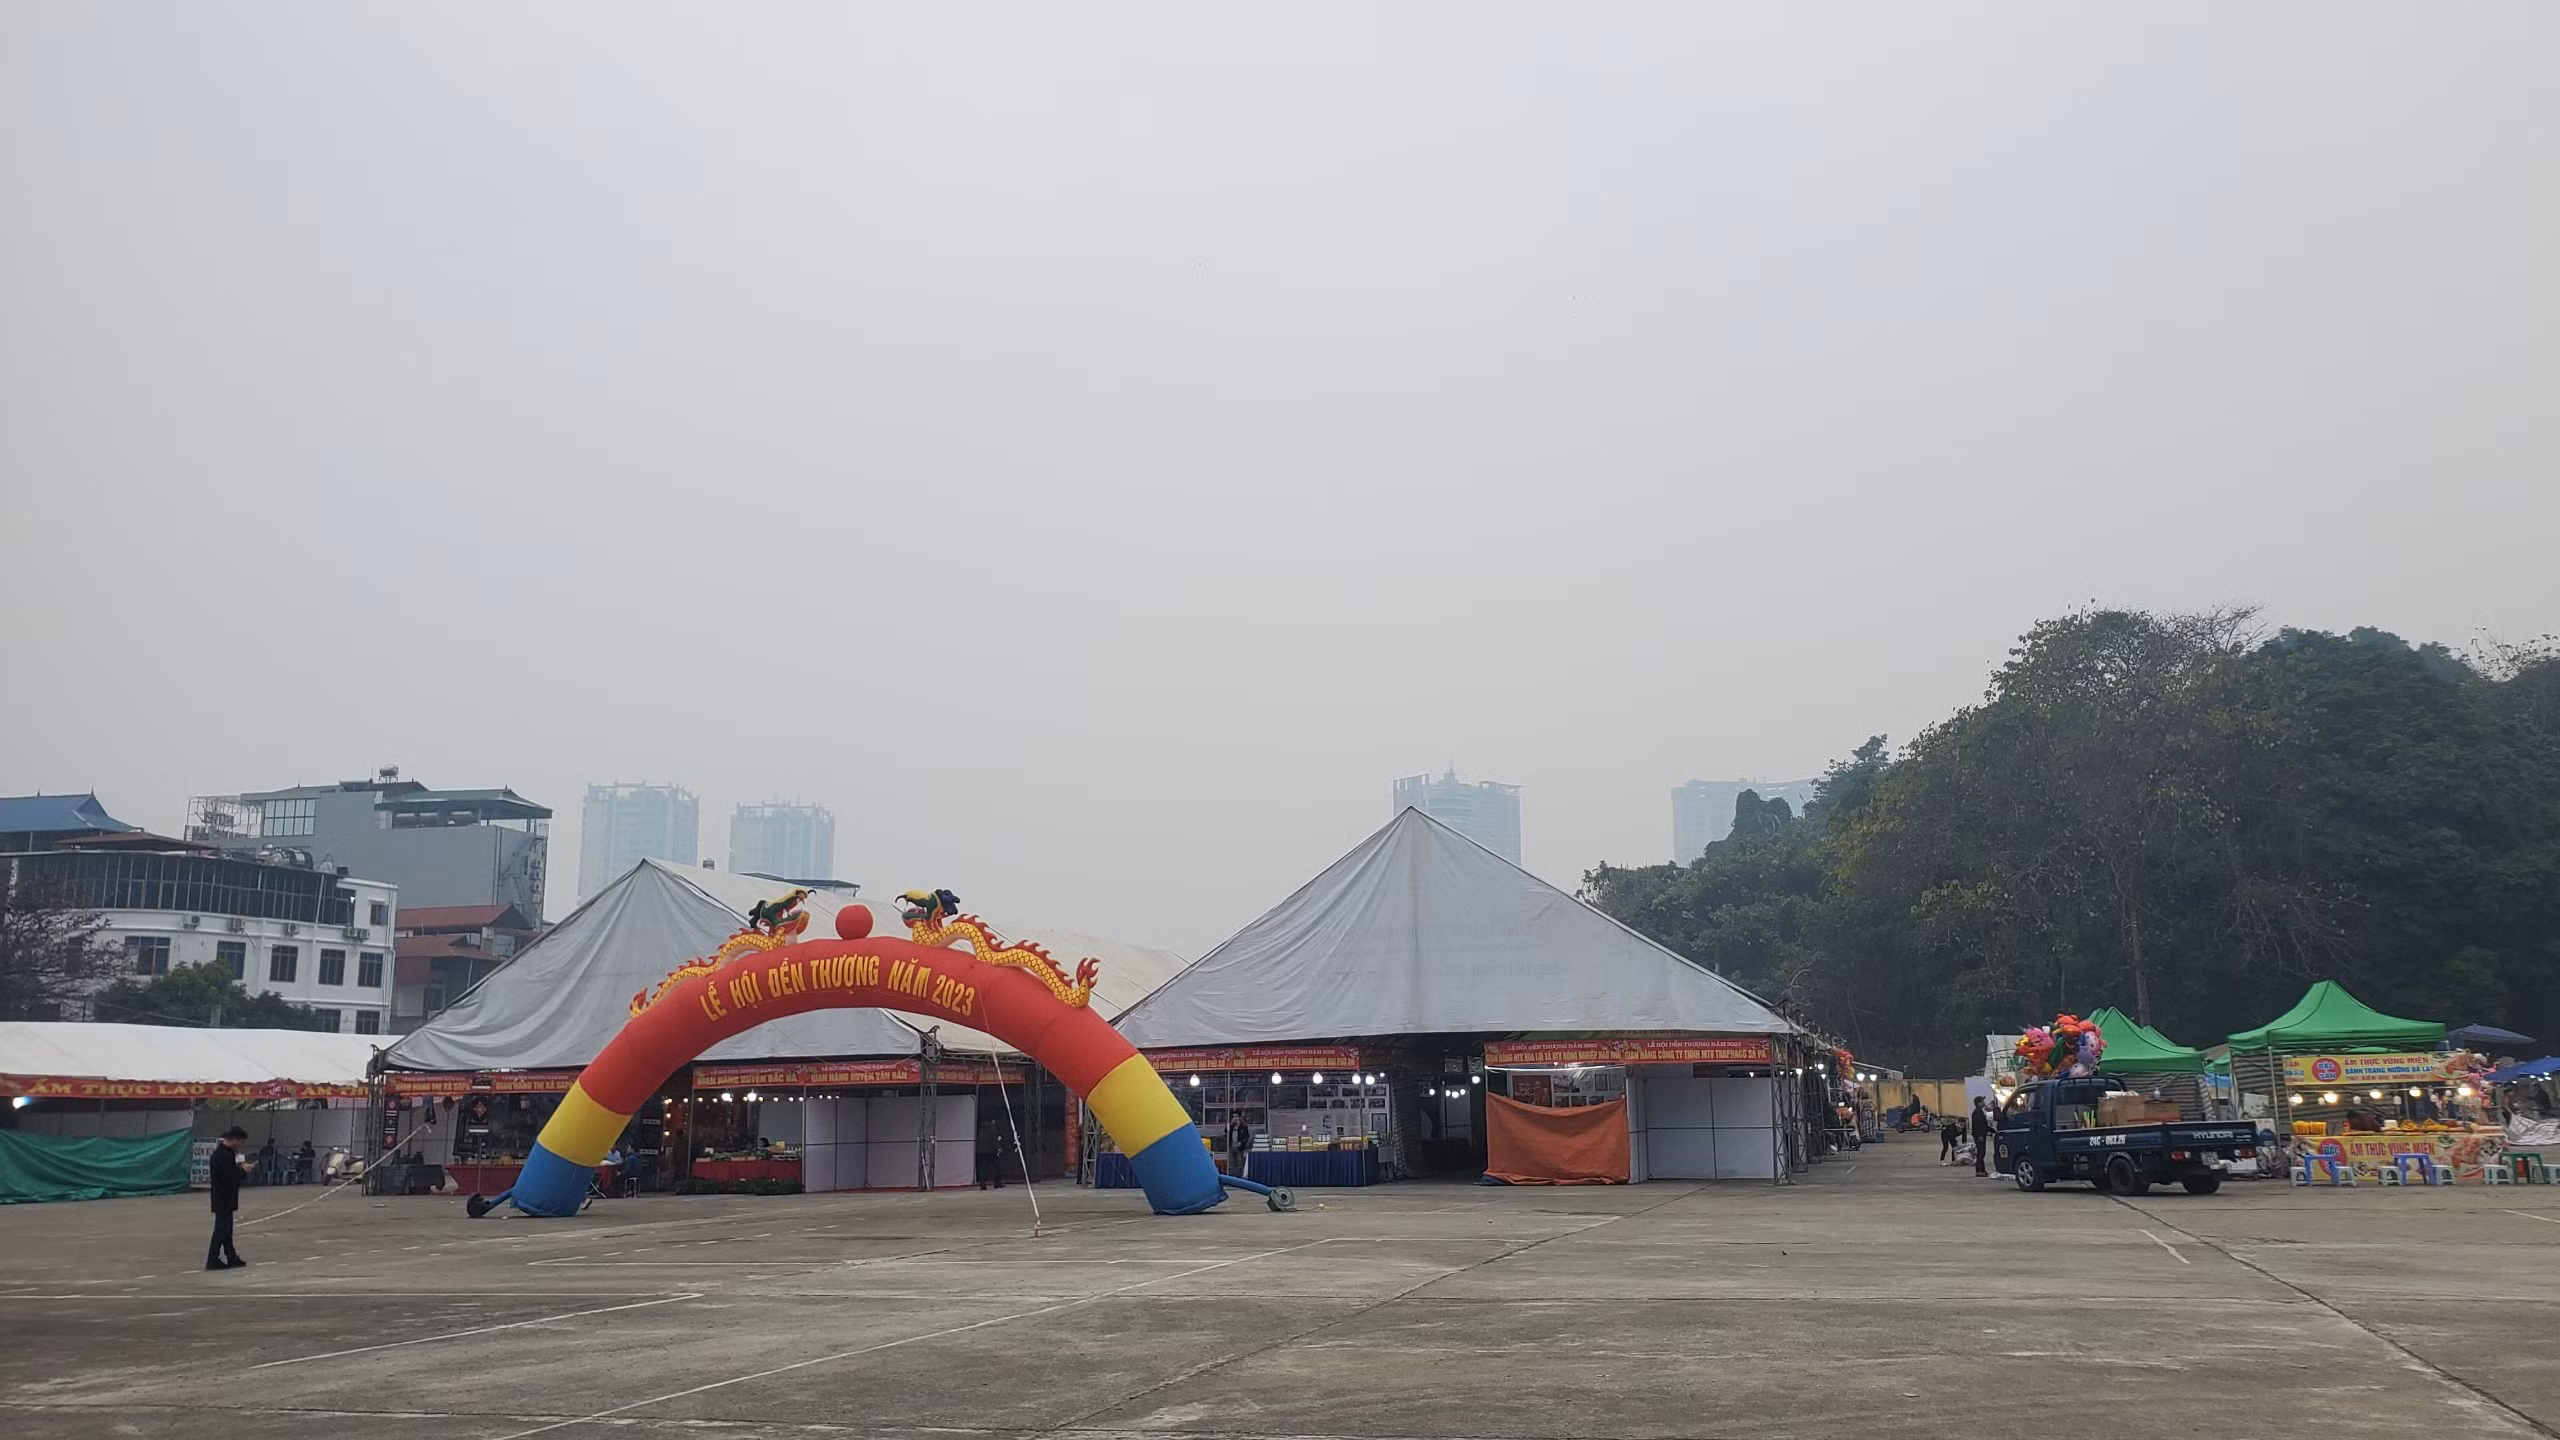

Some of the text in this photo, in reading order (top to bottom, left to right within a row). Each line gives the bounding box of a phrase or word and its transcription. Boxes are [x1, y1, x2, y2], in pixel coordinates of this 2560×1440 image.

[701, 953, 976, 1022] LỄ HỘI ĐỀN THƯỢNG NĂM 2023
[2192, 1130, 2234, 1140] HYUNDAI
[2089, 1136, 2101, 1147] 24C
